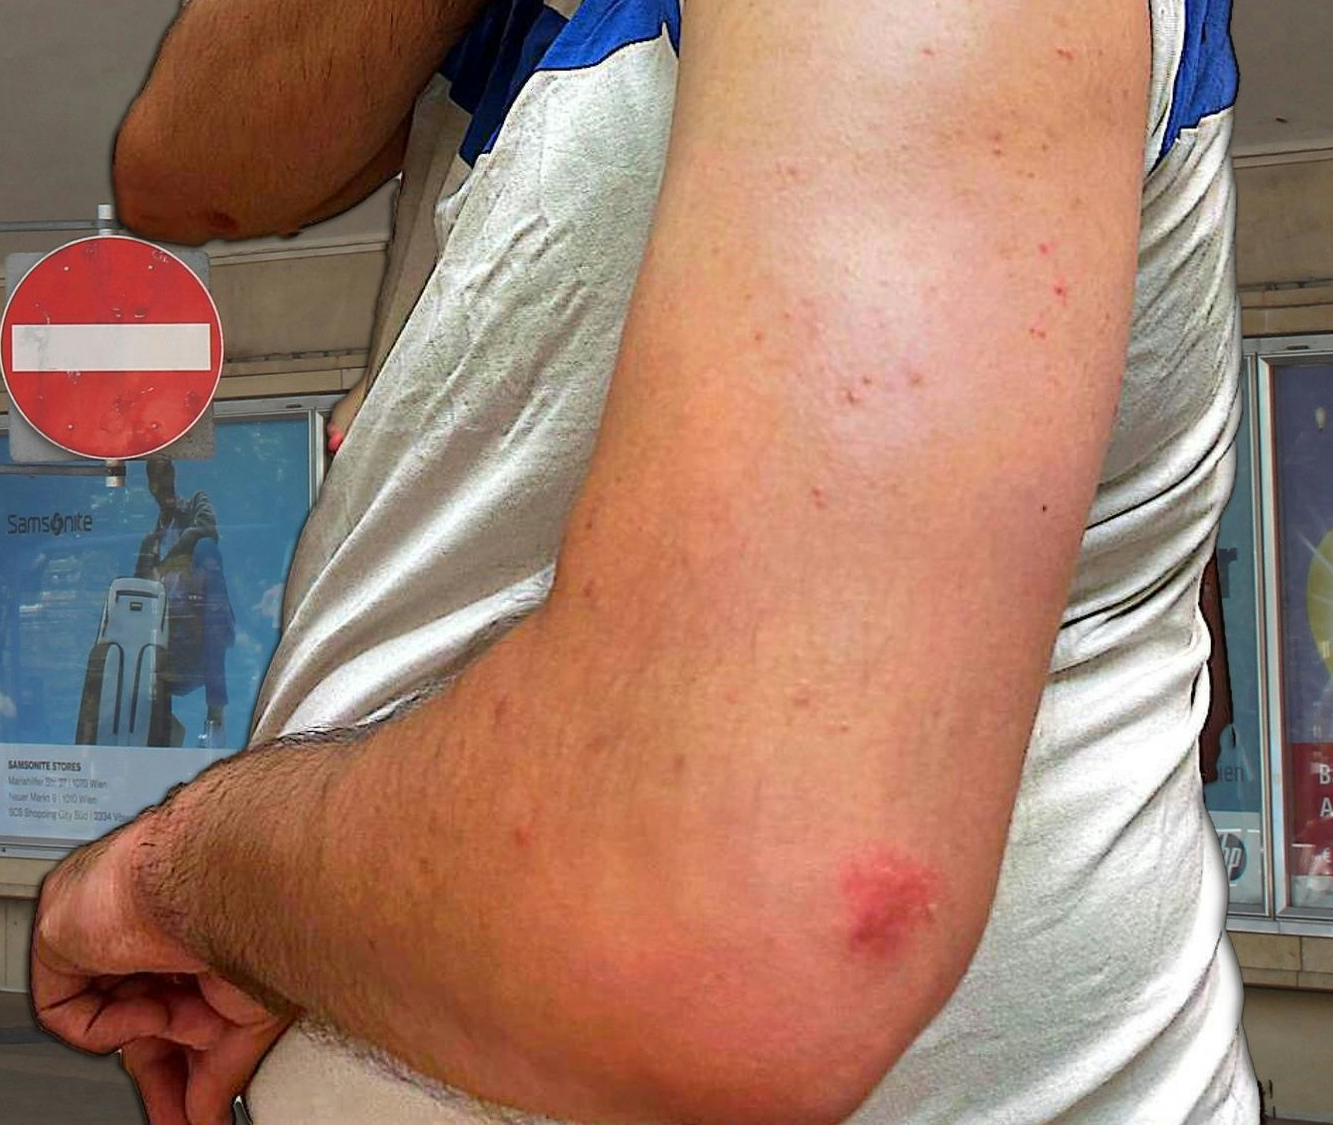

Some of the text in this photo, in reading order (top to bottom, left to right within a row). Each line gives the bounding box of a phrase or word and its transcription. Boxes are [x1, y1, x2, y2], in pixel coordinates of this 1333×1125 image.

[7, 512, 93, 536] Samsonite
[8, 760, 81, 772] SAMSONITE STORES
[1219, 764, 1244, 782] ien
[90, 779, 107, 789] Wien
[25, 808, 57, 820] Shopping
